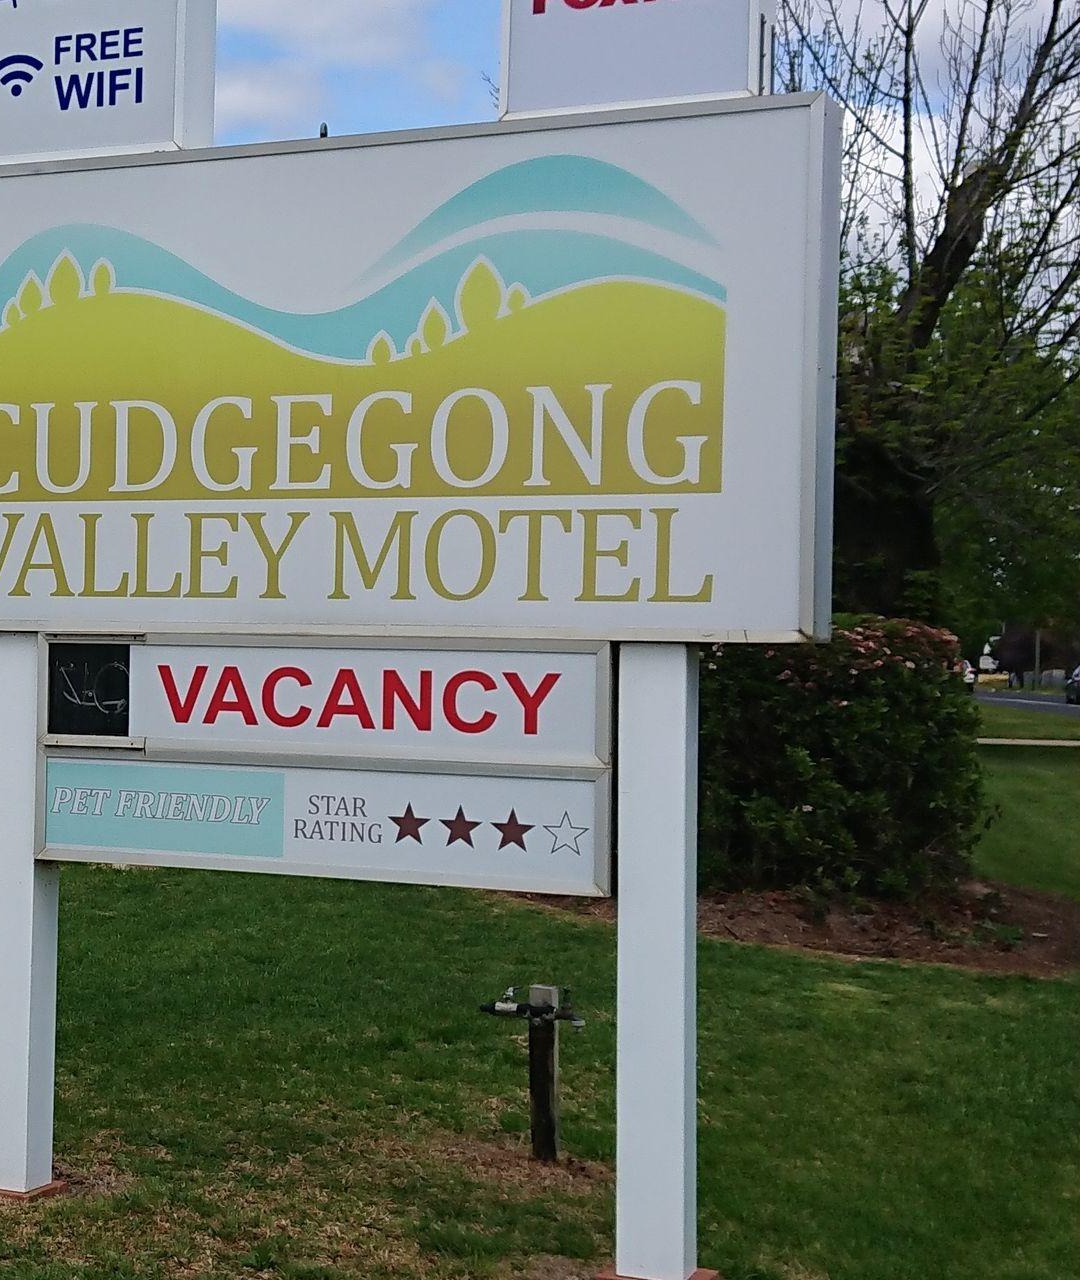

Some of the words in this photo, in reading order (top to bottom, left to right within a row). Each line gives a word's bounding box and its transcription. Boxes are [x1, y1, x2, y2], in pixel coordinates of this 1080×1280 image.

[54, 27, 143, 65] FREE
[54, 67, 143, 110] WIFI
[327, 507, 714, 604] MOTEL
[158, 665, 561, 735] VACANCY
[50, 787, 111, 815] PET
[114, 789, 271, 825] FRIENDLY
[308, 794, 368, 817] STAR
[293, 819, 382, 844] RATING
